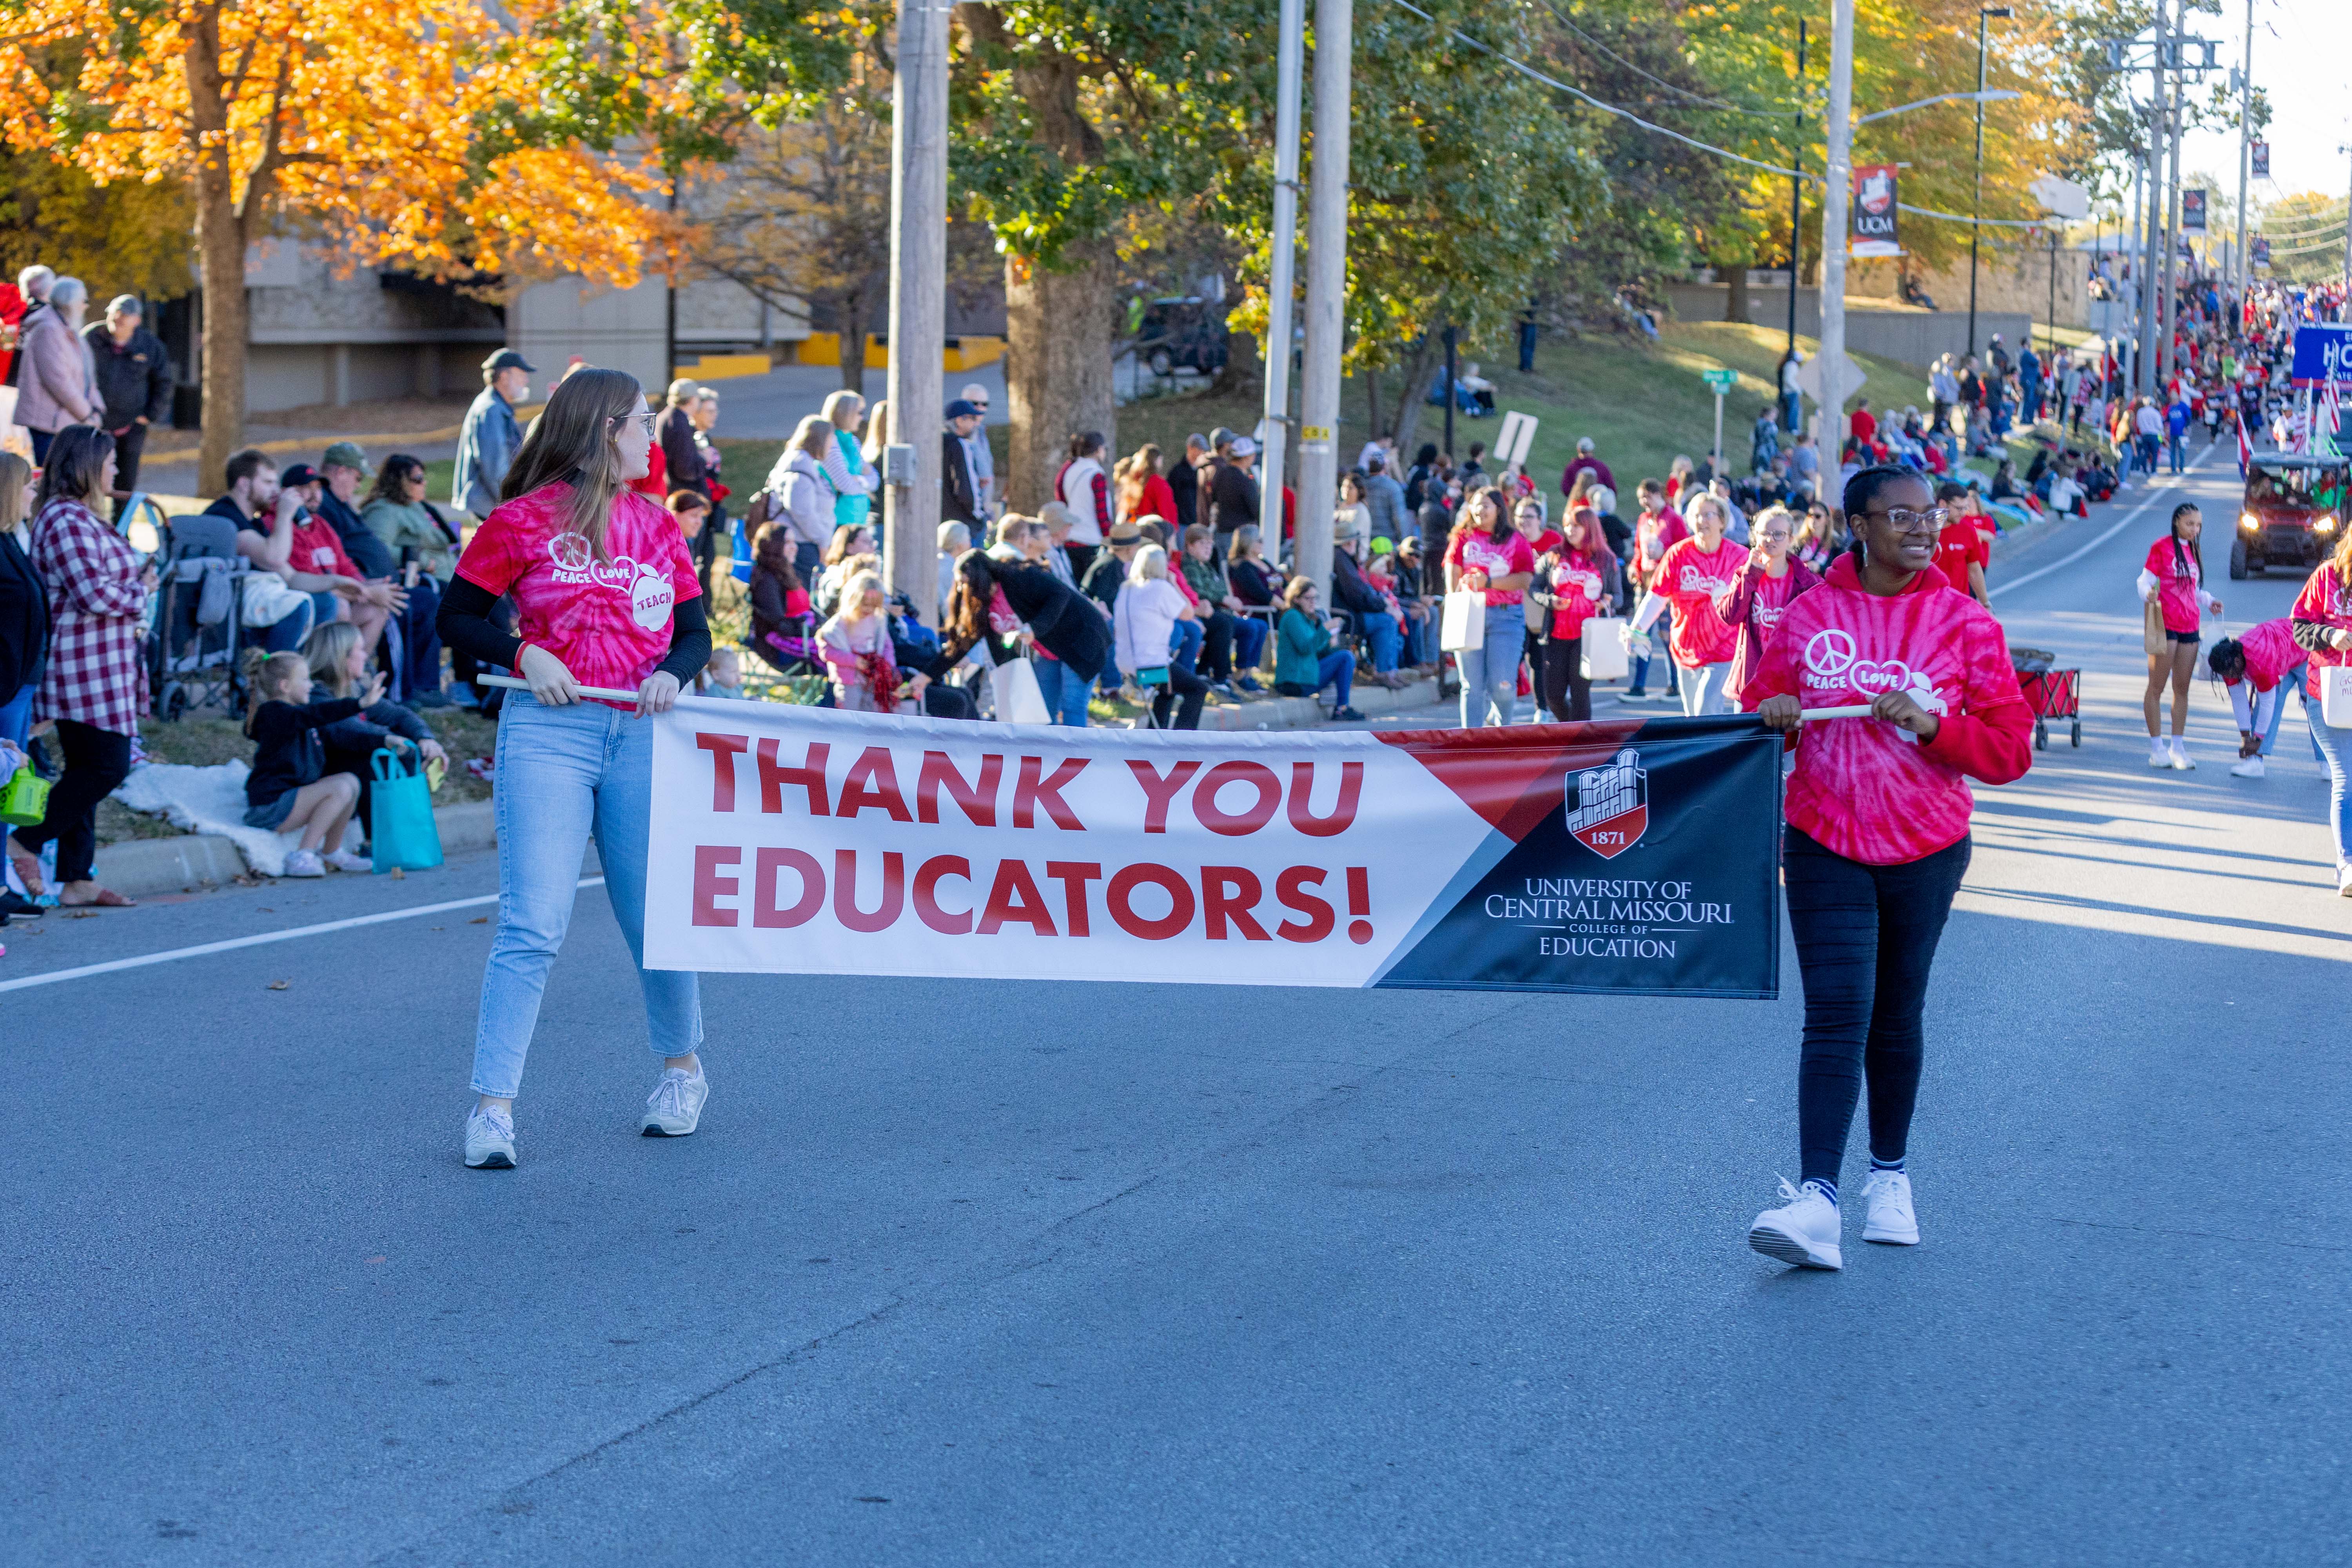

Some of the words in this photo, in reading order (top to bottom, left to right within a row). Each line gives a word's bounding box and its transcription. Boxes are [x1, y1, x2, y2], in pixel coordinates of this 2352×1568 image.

[1858, 216, 1894, 234] UCM
[551, 569, 592, 584] PEACE
[599, 567, 631, 579] LOVE
[637, 592, 671, 610] TEACH
[1764, 613, 1780, 622] LOV
[1806, 673, 1847, 690] PEACE
[1860, 670, 1898, 688] LOVE
[695, 731, 1092, 831] THANK
[1123, 759, 1364, 837] YOU
[1591, 831, 1625, 844] 1871
[692, 845, 1374, 945] EDUCATORS!
[1525, 878, 1659, 898] UNIVERSITY
[1661, 881, 1692, 900] OF
[1485, 894, 1605, 920] CENTRAL
[1609, 900, 1732, 924] MISSOURI
[1569, 923, 1626, 934] COLLEGE
[1632, 925, 1648, 935] OF
[1539, 937, 1676, 958] EDUCATION
